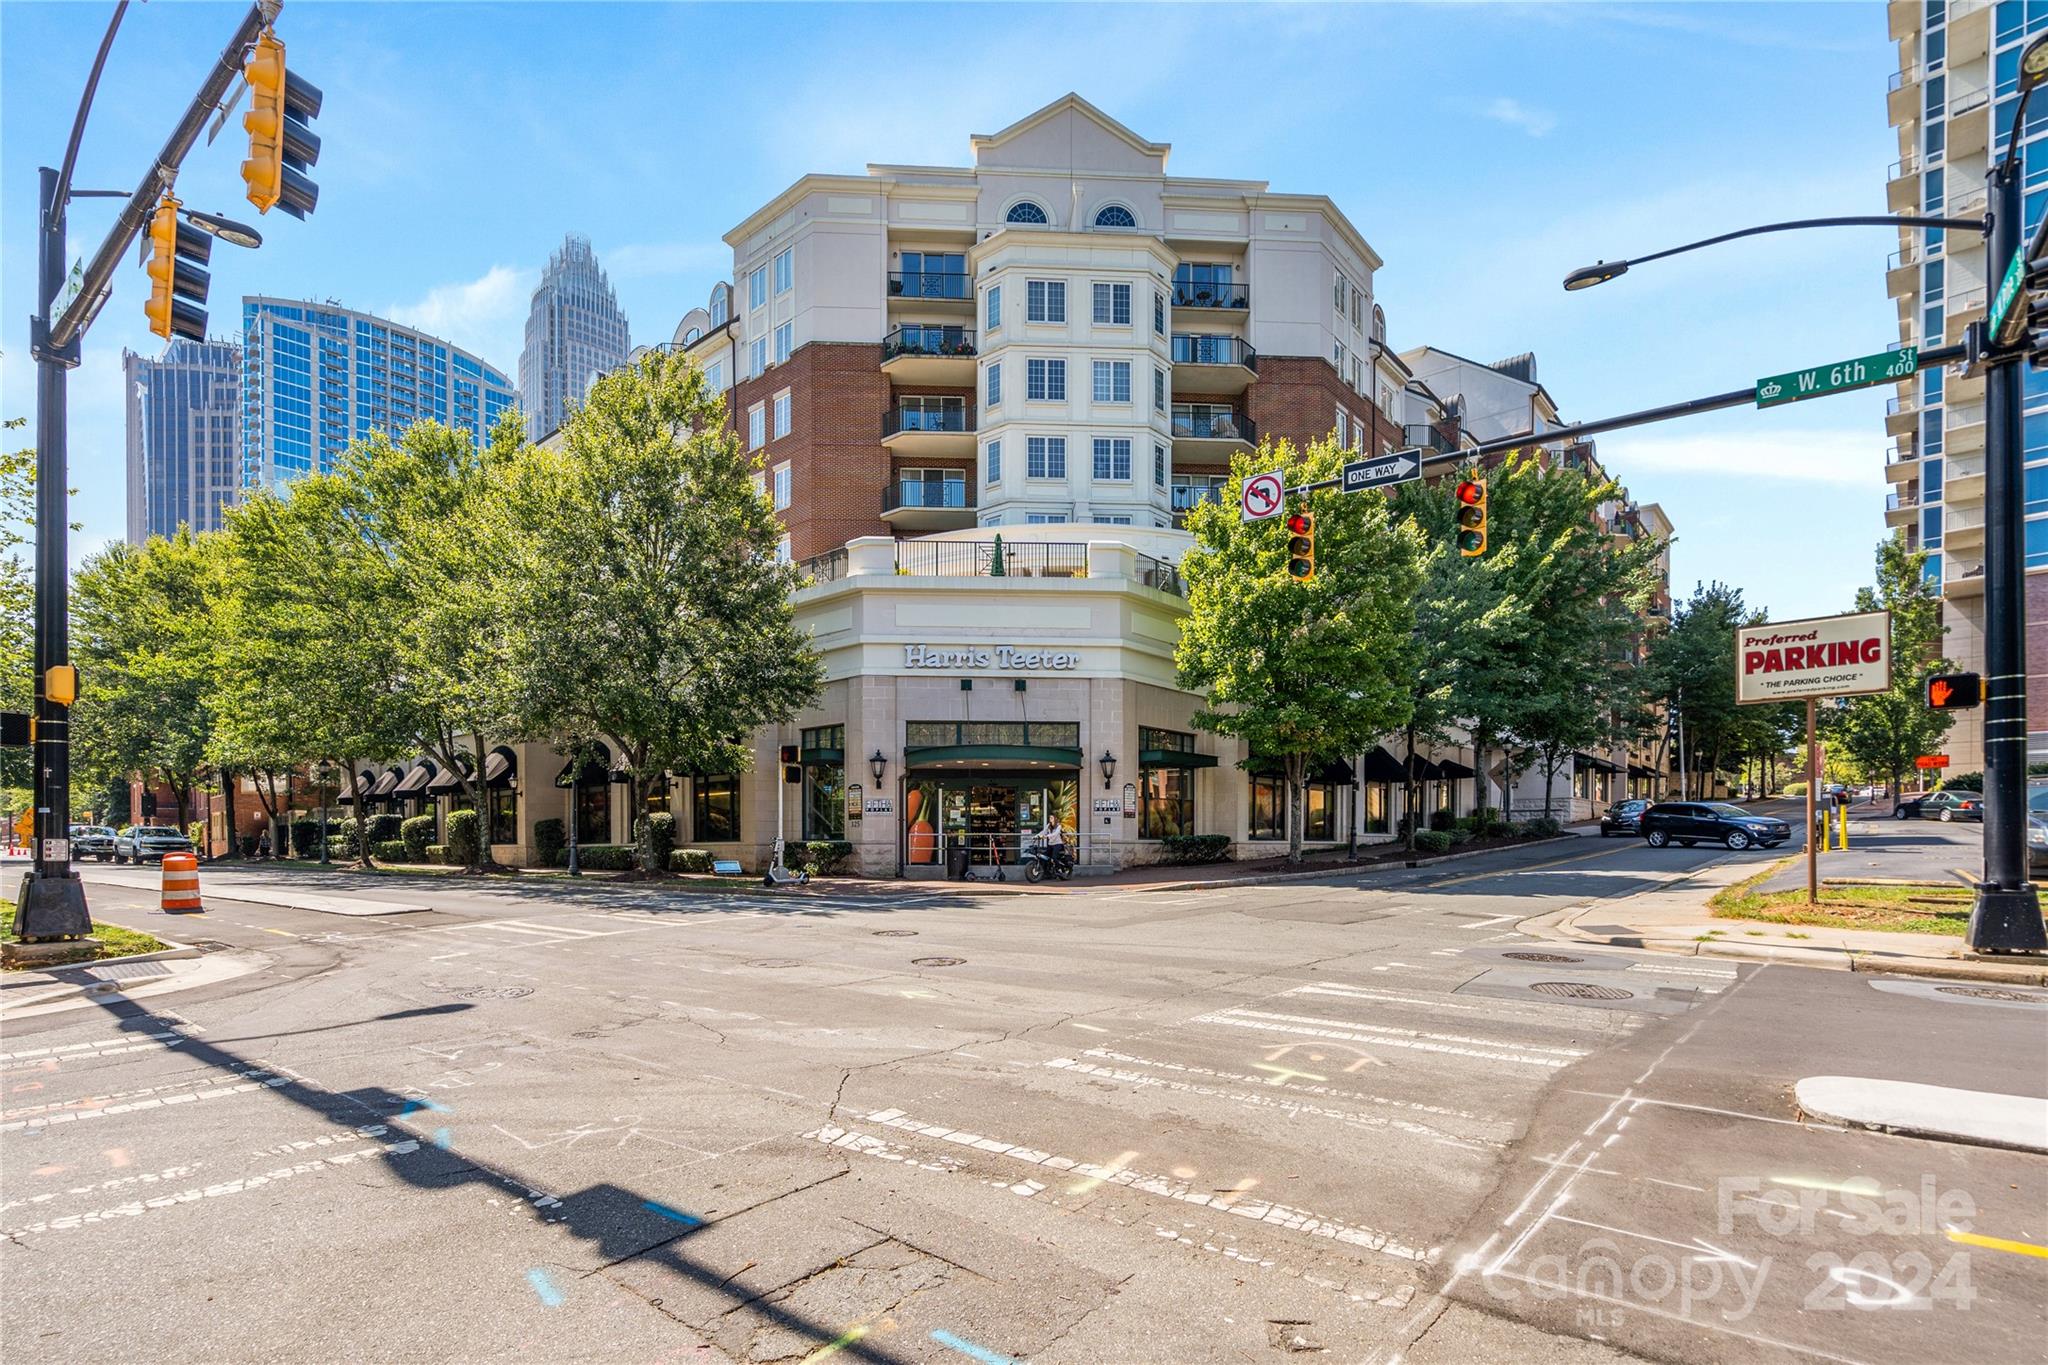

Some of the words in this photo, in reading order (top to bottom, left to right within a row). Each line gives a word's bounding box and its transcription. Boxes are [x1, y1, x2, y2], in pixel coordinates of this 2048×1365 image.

[1898, 349, 1913, 363] St
[1798, 371, 1821, 392] W.
[1830, 361, 1866, 387] 6th
[1886, 361, 1913, 376] 400
[1351, 470, 1371, 481] ONE
[1375, 464, 1396, 477] WAY
[1744, 630, 1818, 647] Preferred
[904, 644, 991, 669] Harris
[995, 645, 1080, 670] Teeter
[1744, 638, 1881, 675] PARKING
[1783, 676, 1821, 688] PARKING
